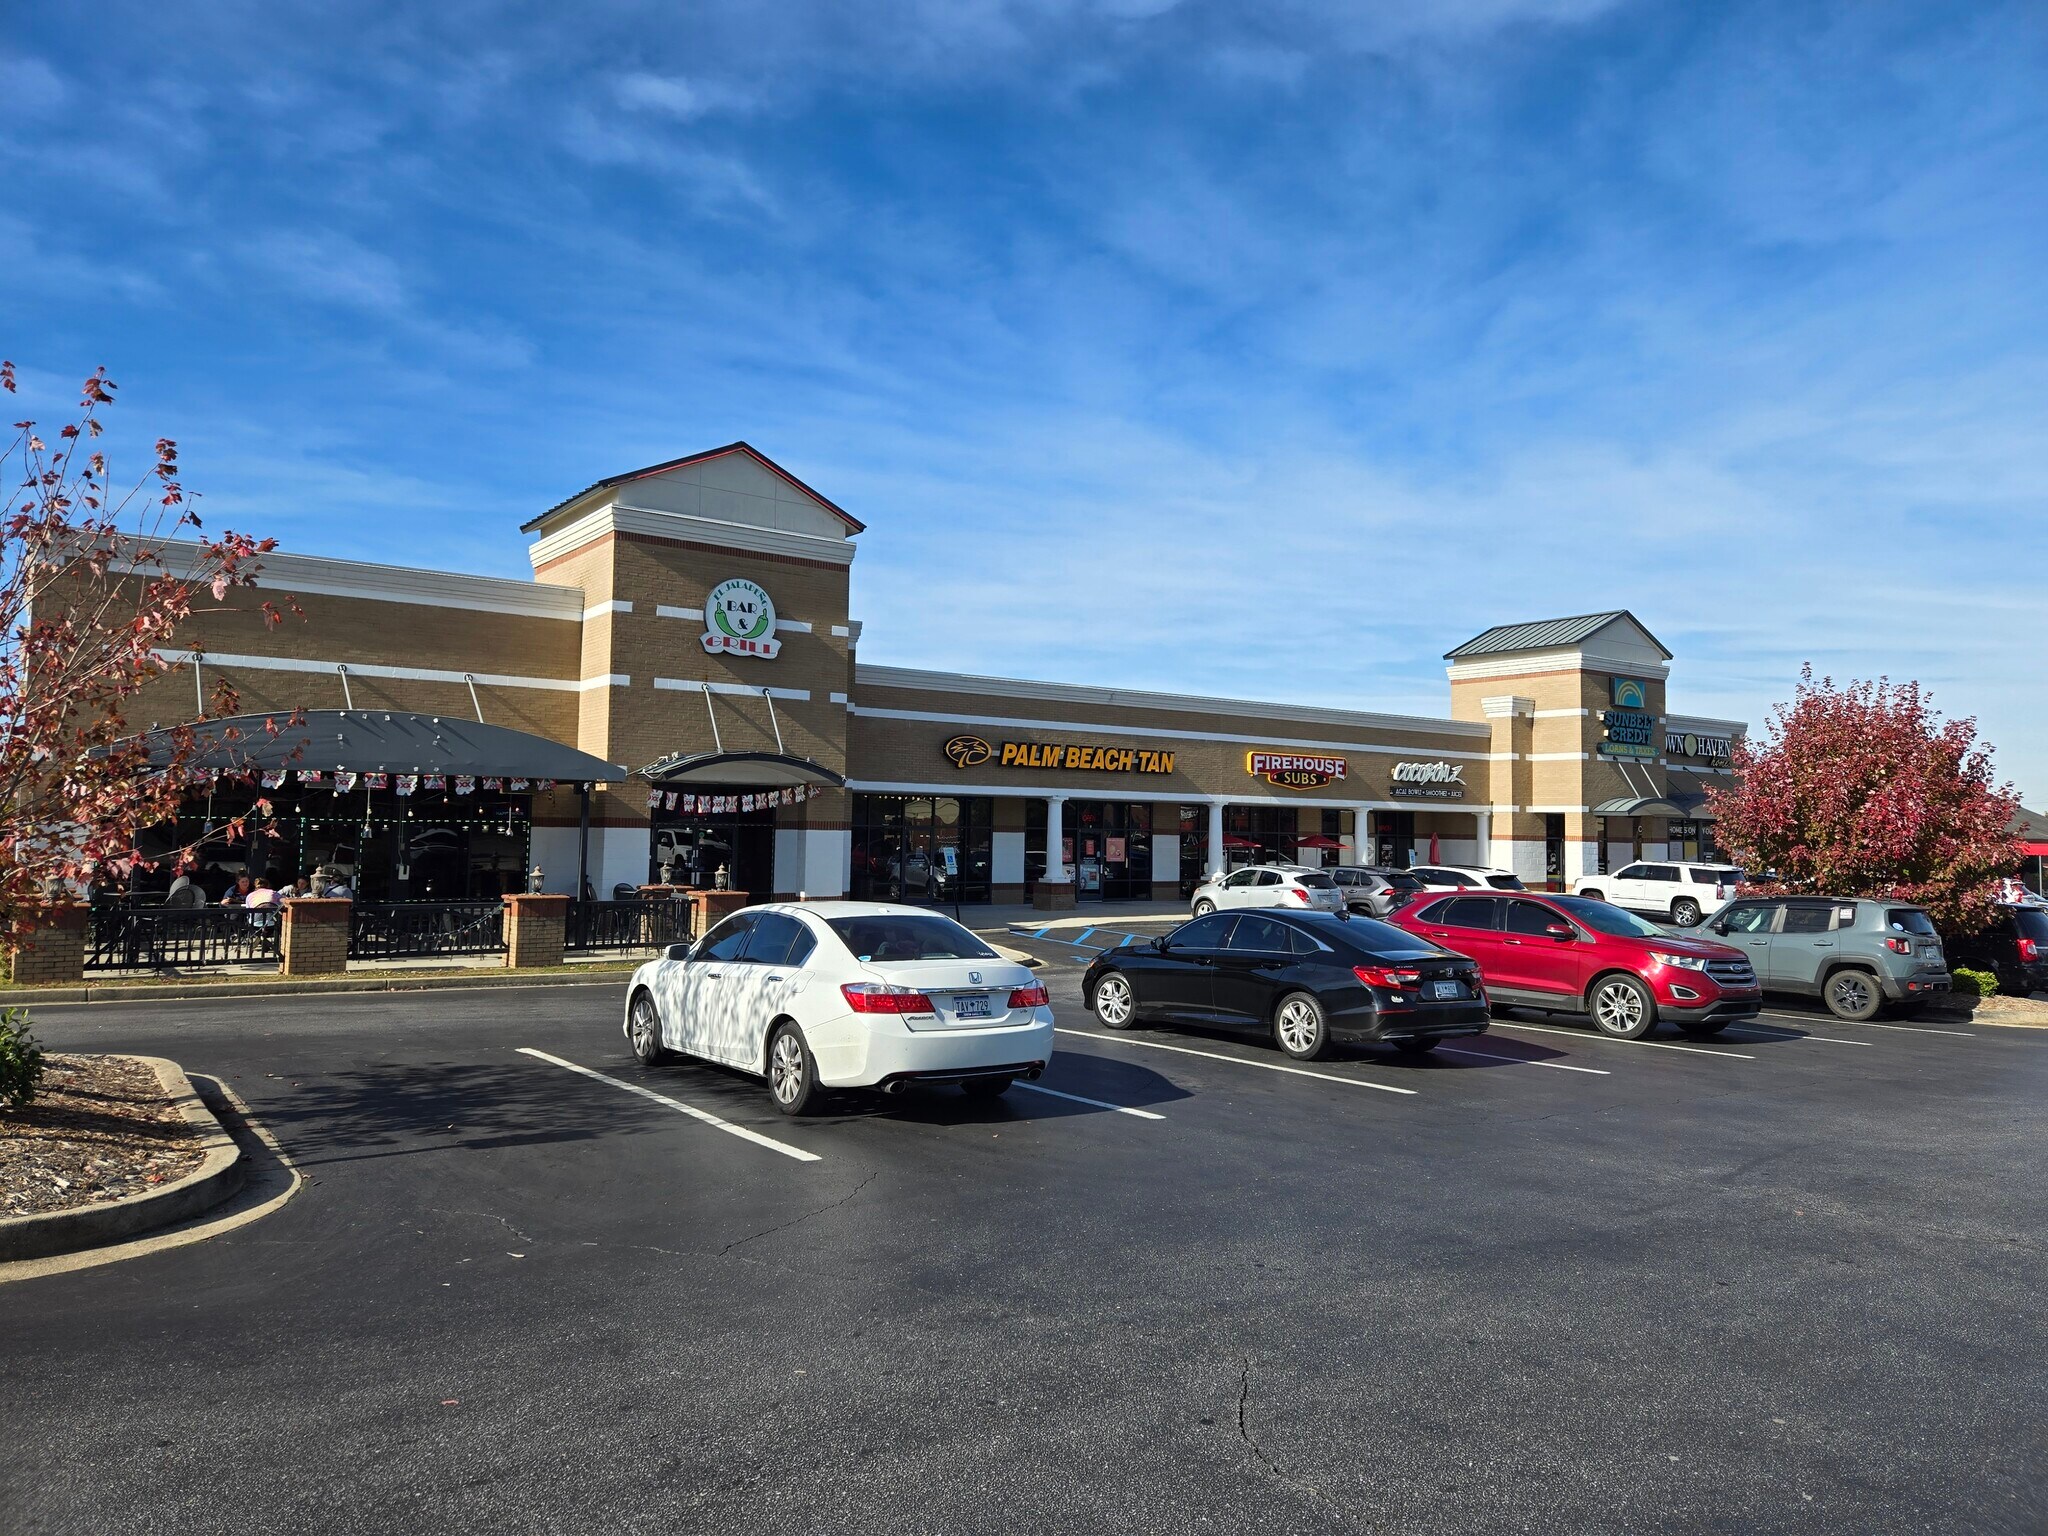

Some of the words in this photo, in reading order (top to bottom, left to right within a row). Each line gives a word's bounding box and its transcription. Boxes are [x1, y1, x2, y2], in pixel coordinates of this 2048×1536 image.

[727, 600, 757, 614] BAR
[738, 618, 748, 630] &
[706, 636, 776, 654] GRILL
[1605, 711, 1656, 730] SUNBELT
[1610, 727, 1652, 744] CREDIT
[1605, 744, 1627, 754] LOANS
[1635, 746, 1655, 755] TAXES
[1697, 737, 1731, 757] HAVEN
[1001, 743, 1061, 767] PALM
[1065, 747, 1133, 771] BEACH
[1139, 751, 1175, 773] TAN
[1253, 755, 1345, 779] FIREHOUSE
[1284, 772, 1317, 785] SUBS
[956, 1001, 968, 1012] TAV
[975, 1000, 988, 1011] 729
